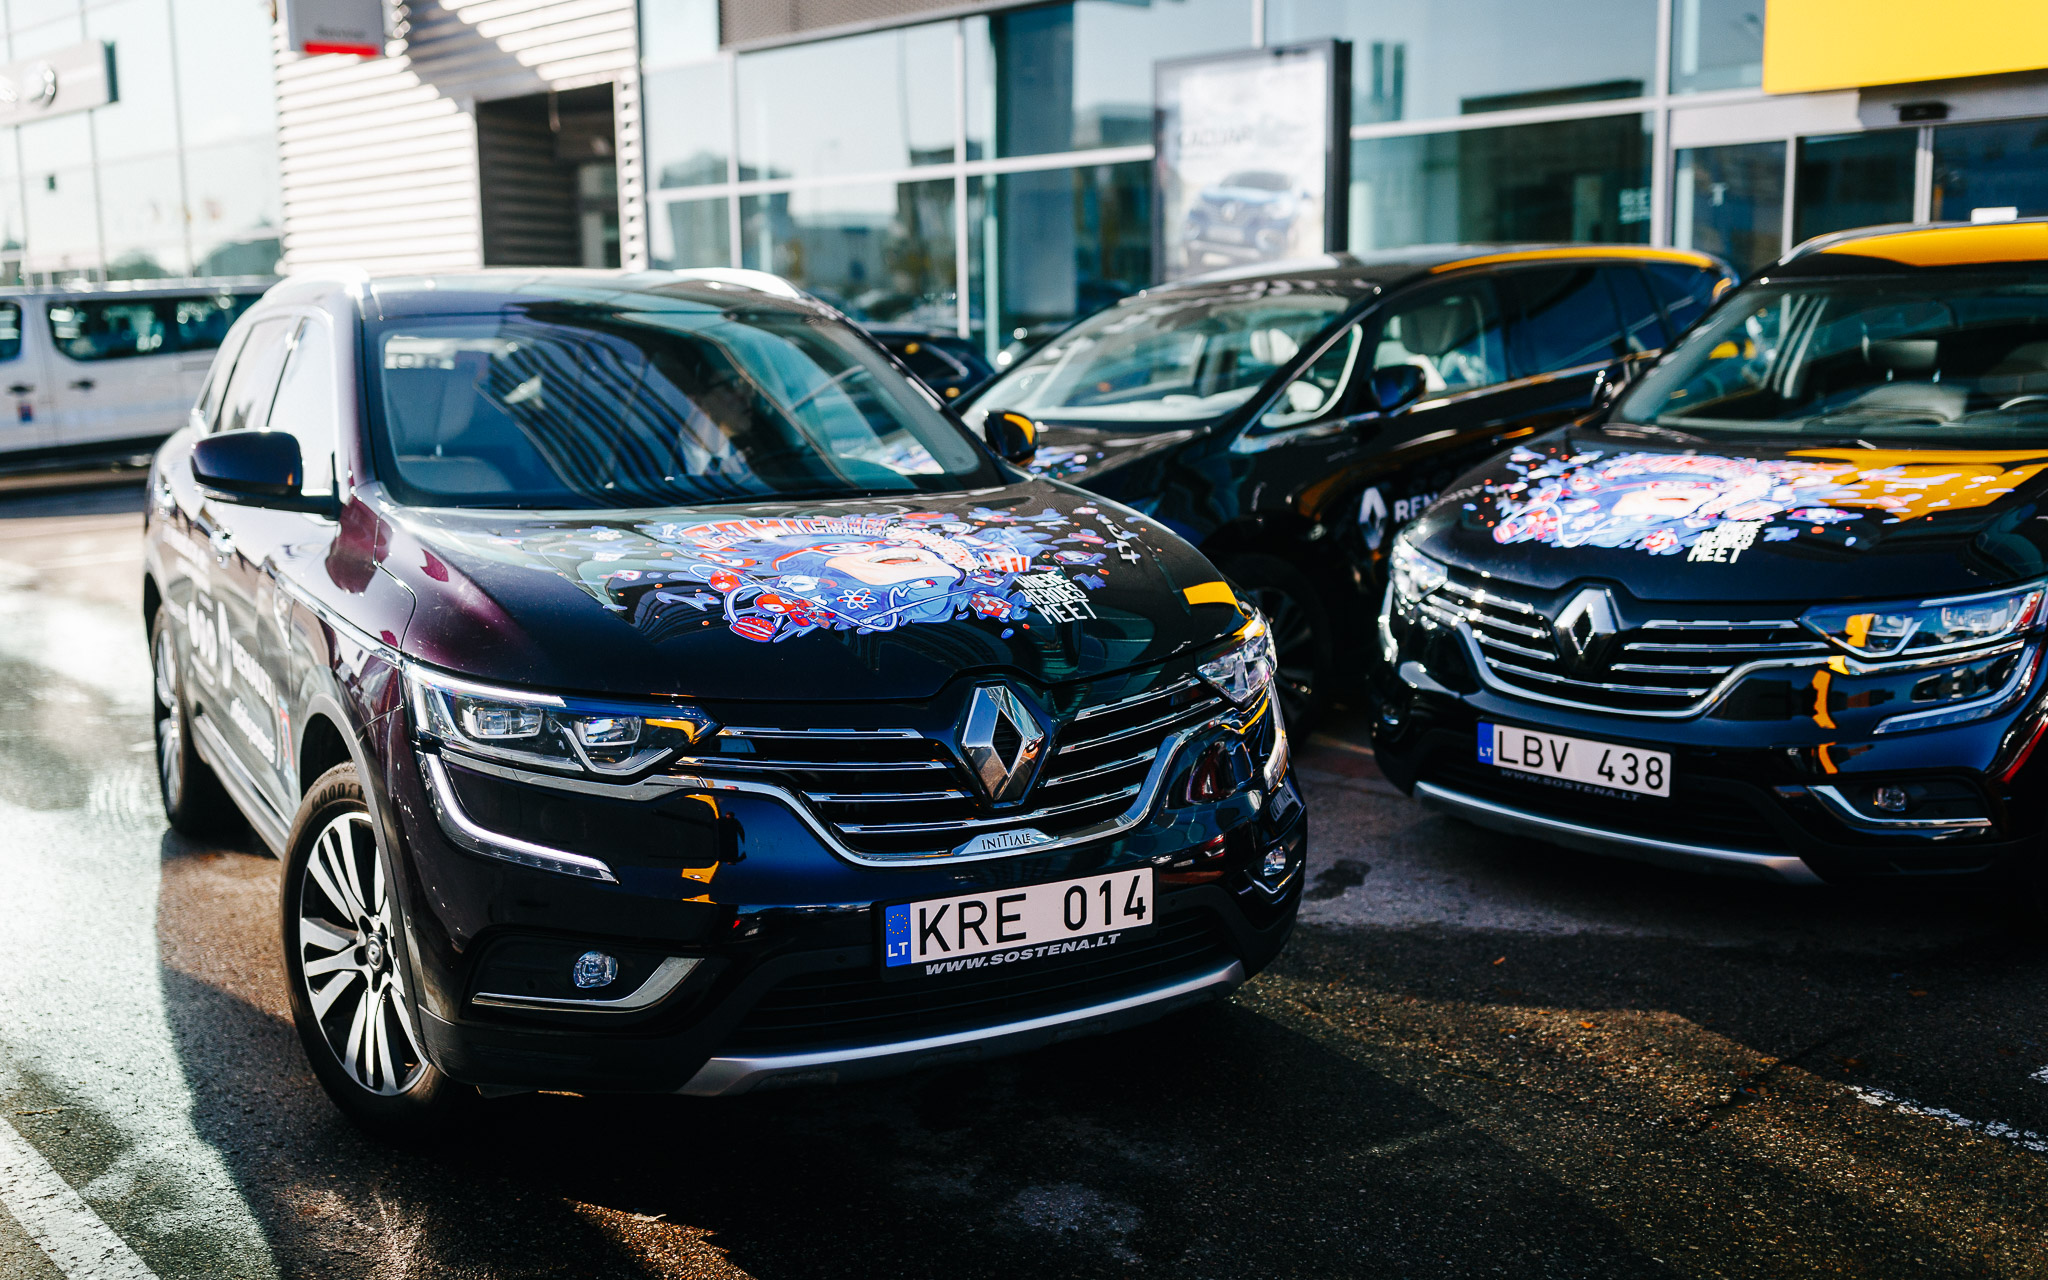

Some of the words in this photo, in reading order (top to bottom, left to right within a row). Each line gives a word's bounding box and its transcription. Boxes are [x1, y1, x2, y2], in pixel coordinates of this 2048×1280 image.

[1687, 546, 1742, 564] MEET
[1012, 571, 1071, 589] WHERE
[1019, 583, 1087, 605] HEROES
[1034, 599, 1097, 624] MEET
[1498, 730, 1570, 773] LBV
[1597, 749, 1664, 790] 438
[981, 832, 1032, 850] INITIALE
[919, 893, 1027, 956] KRE
[1063, 875, 1147, 931] 014
[887, 941, 908, 958] LT
[925, 933, 1121, 976] WWW.SOSTENA.LT
